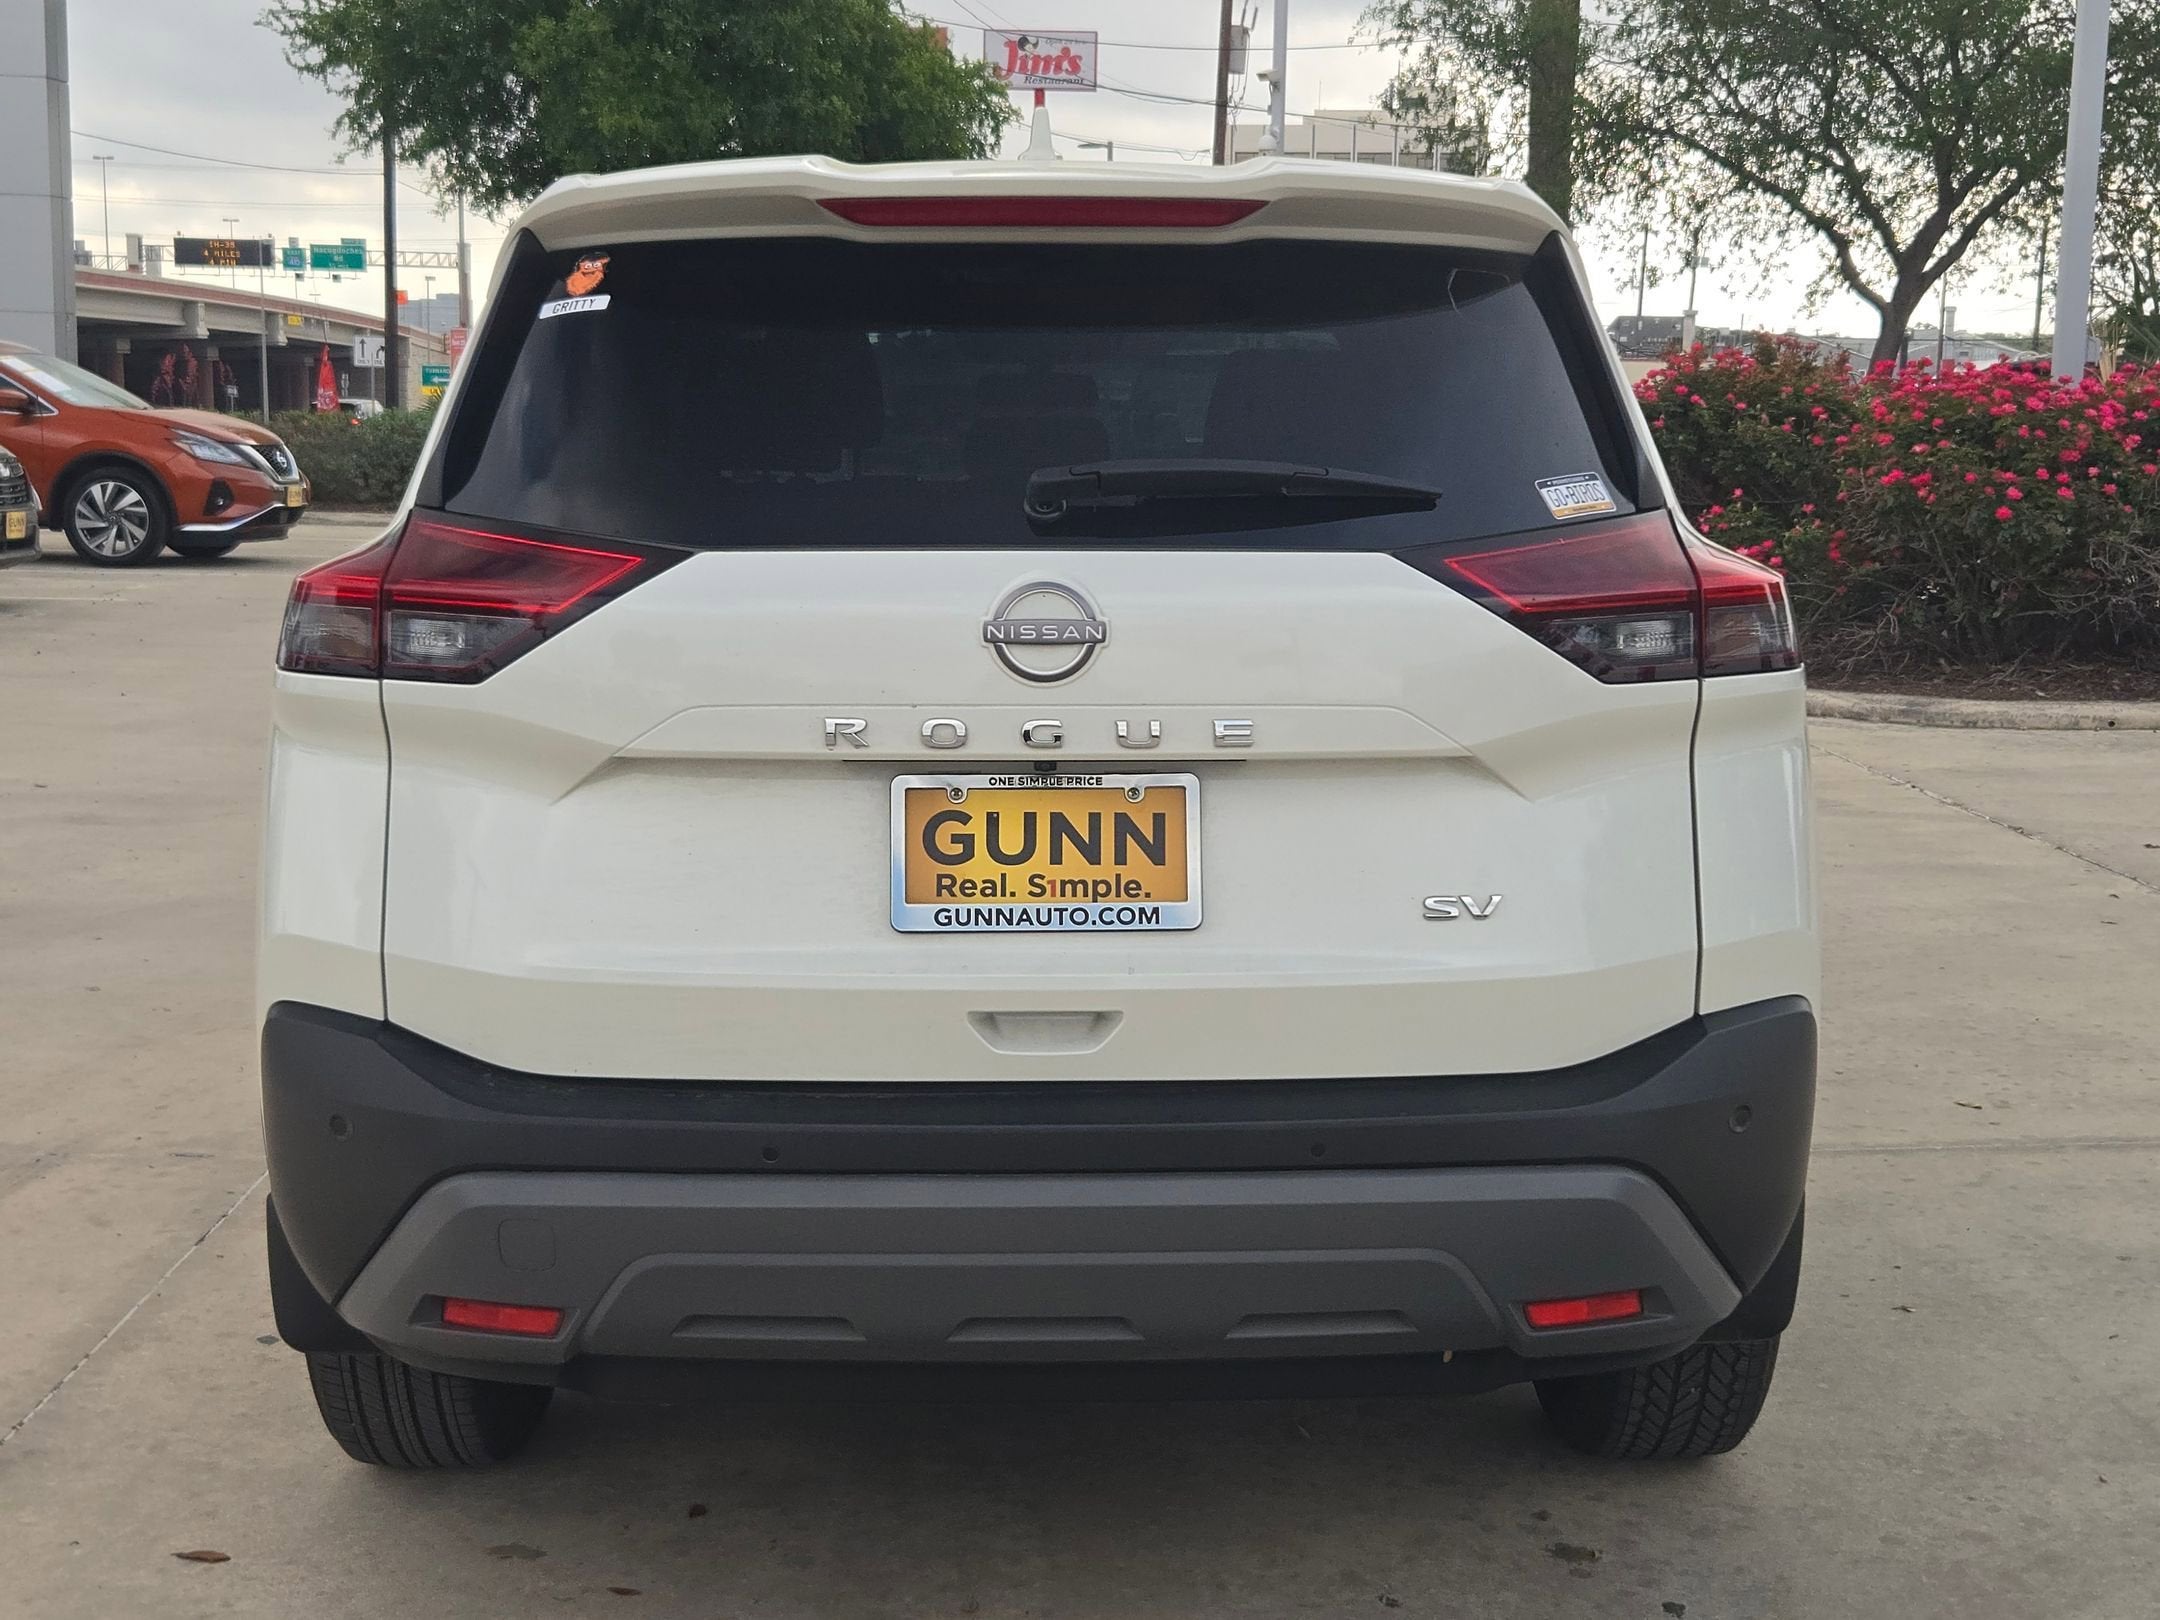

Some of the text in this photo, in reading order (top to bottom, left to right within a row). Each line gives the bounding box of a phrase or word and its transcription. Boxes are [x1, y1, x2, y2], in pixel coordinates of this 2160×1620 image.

[993, 40, 1083, 80] Jim's
[1024, 76, 1084, 85] Restaurant
[552, 299, 597, 315] GRITTY
[986, 625, 1104, 641] NISSAN
[824, 716, 1255, 749] ROGUE
[988, 776, 1016, 787] ONE
[1066, 776, 1103, 787] PRICE
[921, 809, 1167, 867] GUNN
[935, 873, 1016, 898] Real.
[933, 906, 1161, 927] GUNNAUTO.COM
[1423, 894, 1503, 920] SV
